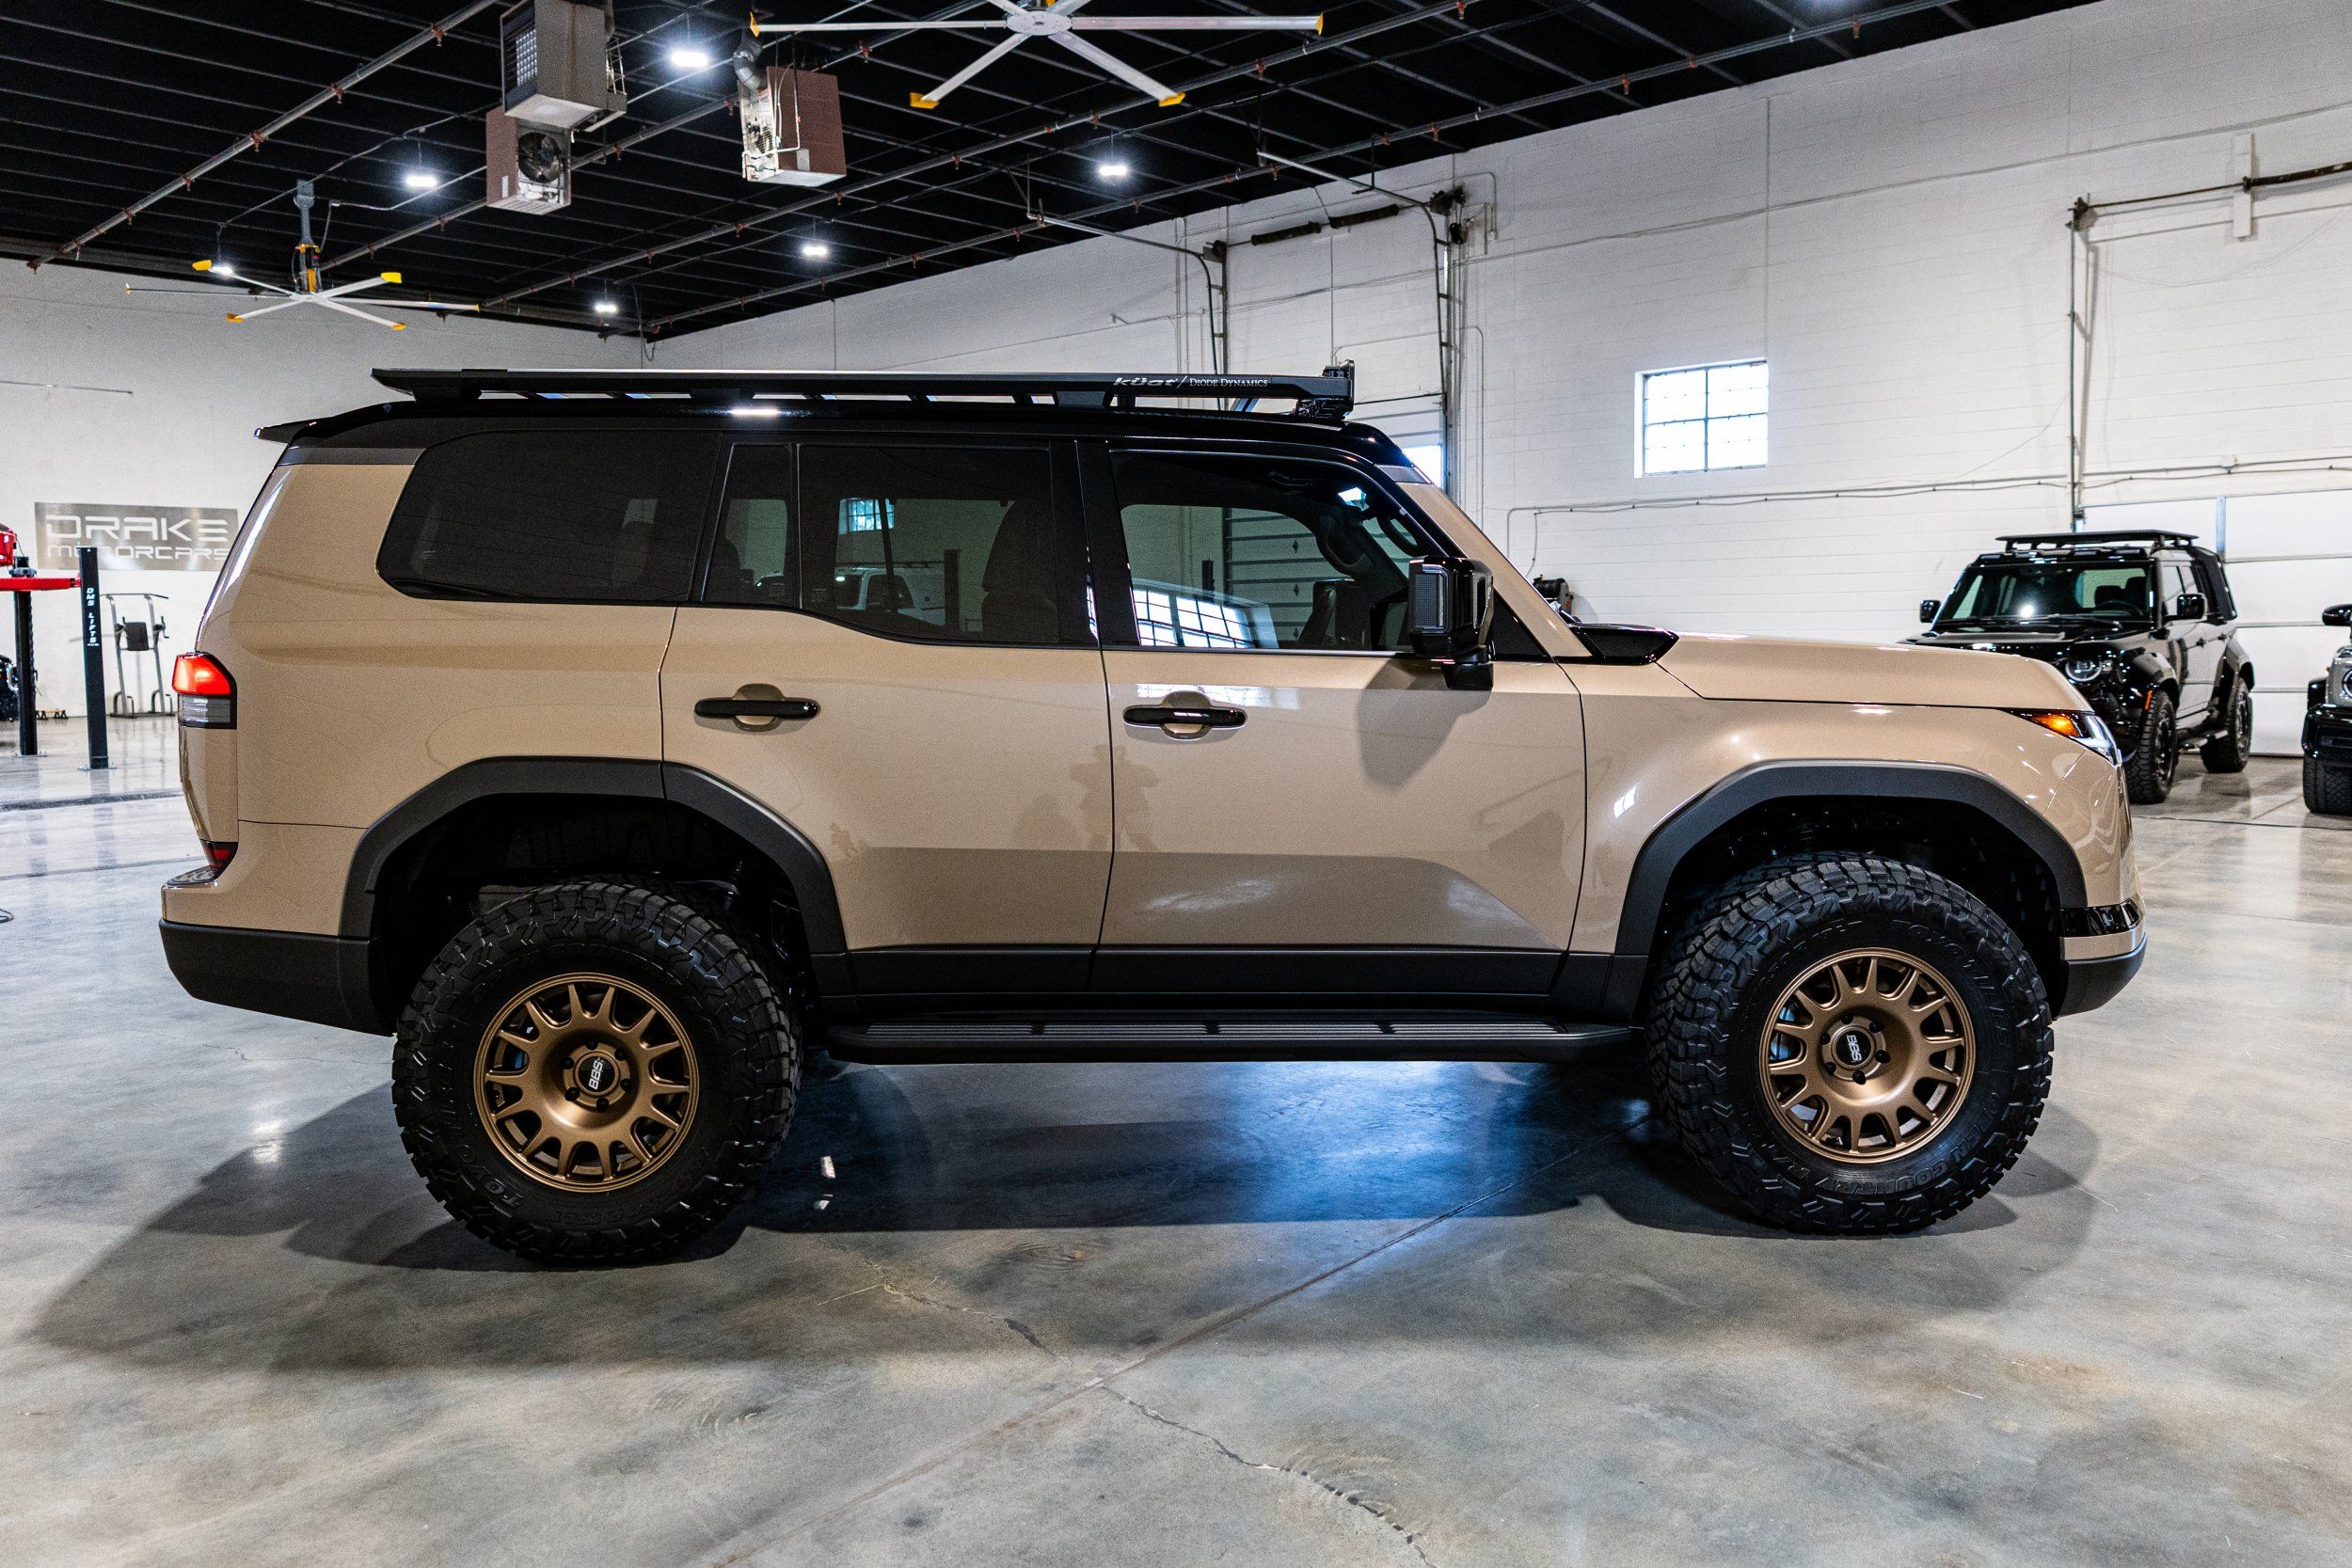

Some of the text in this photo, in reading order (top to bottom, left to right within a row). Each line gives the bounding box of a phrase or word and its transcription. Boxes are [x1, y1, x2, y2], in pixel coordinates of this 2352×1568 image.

[1189, 377, 1218, 388] DIODE
[1220, 377, 1268, 388] DYNAMICS
[46, 514, 229, 543] DRAKE
[47, 545, 230, 561] MTORCARS
[1847, 1035, 1862, 1062] BBS
[588, 1059, 603, 1090] BBS
[1815, 1159, 1948, 1196] COUNTRY
